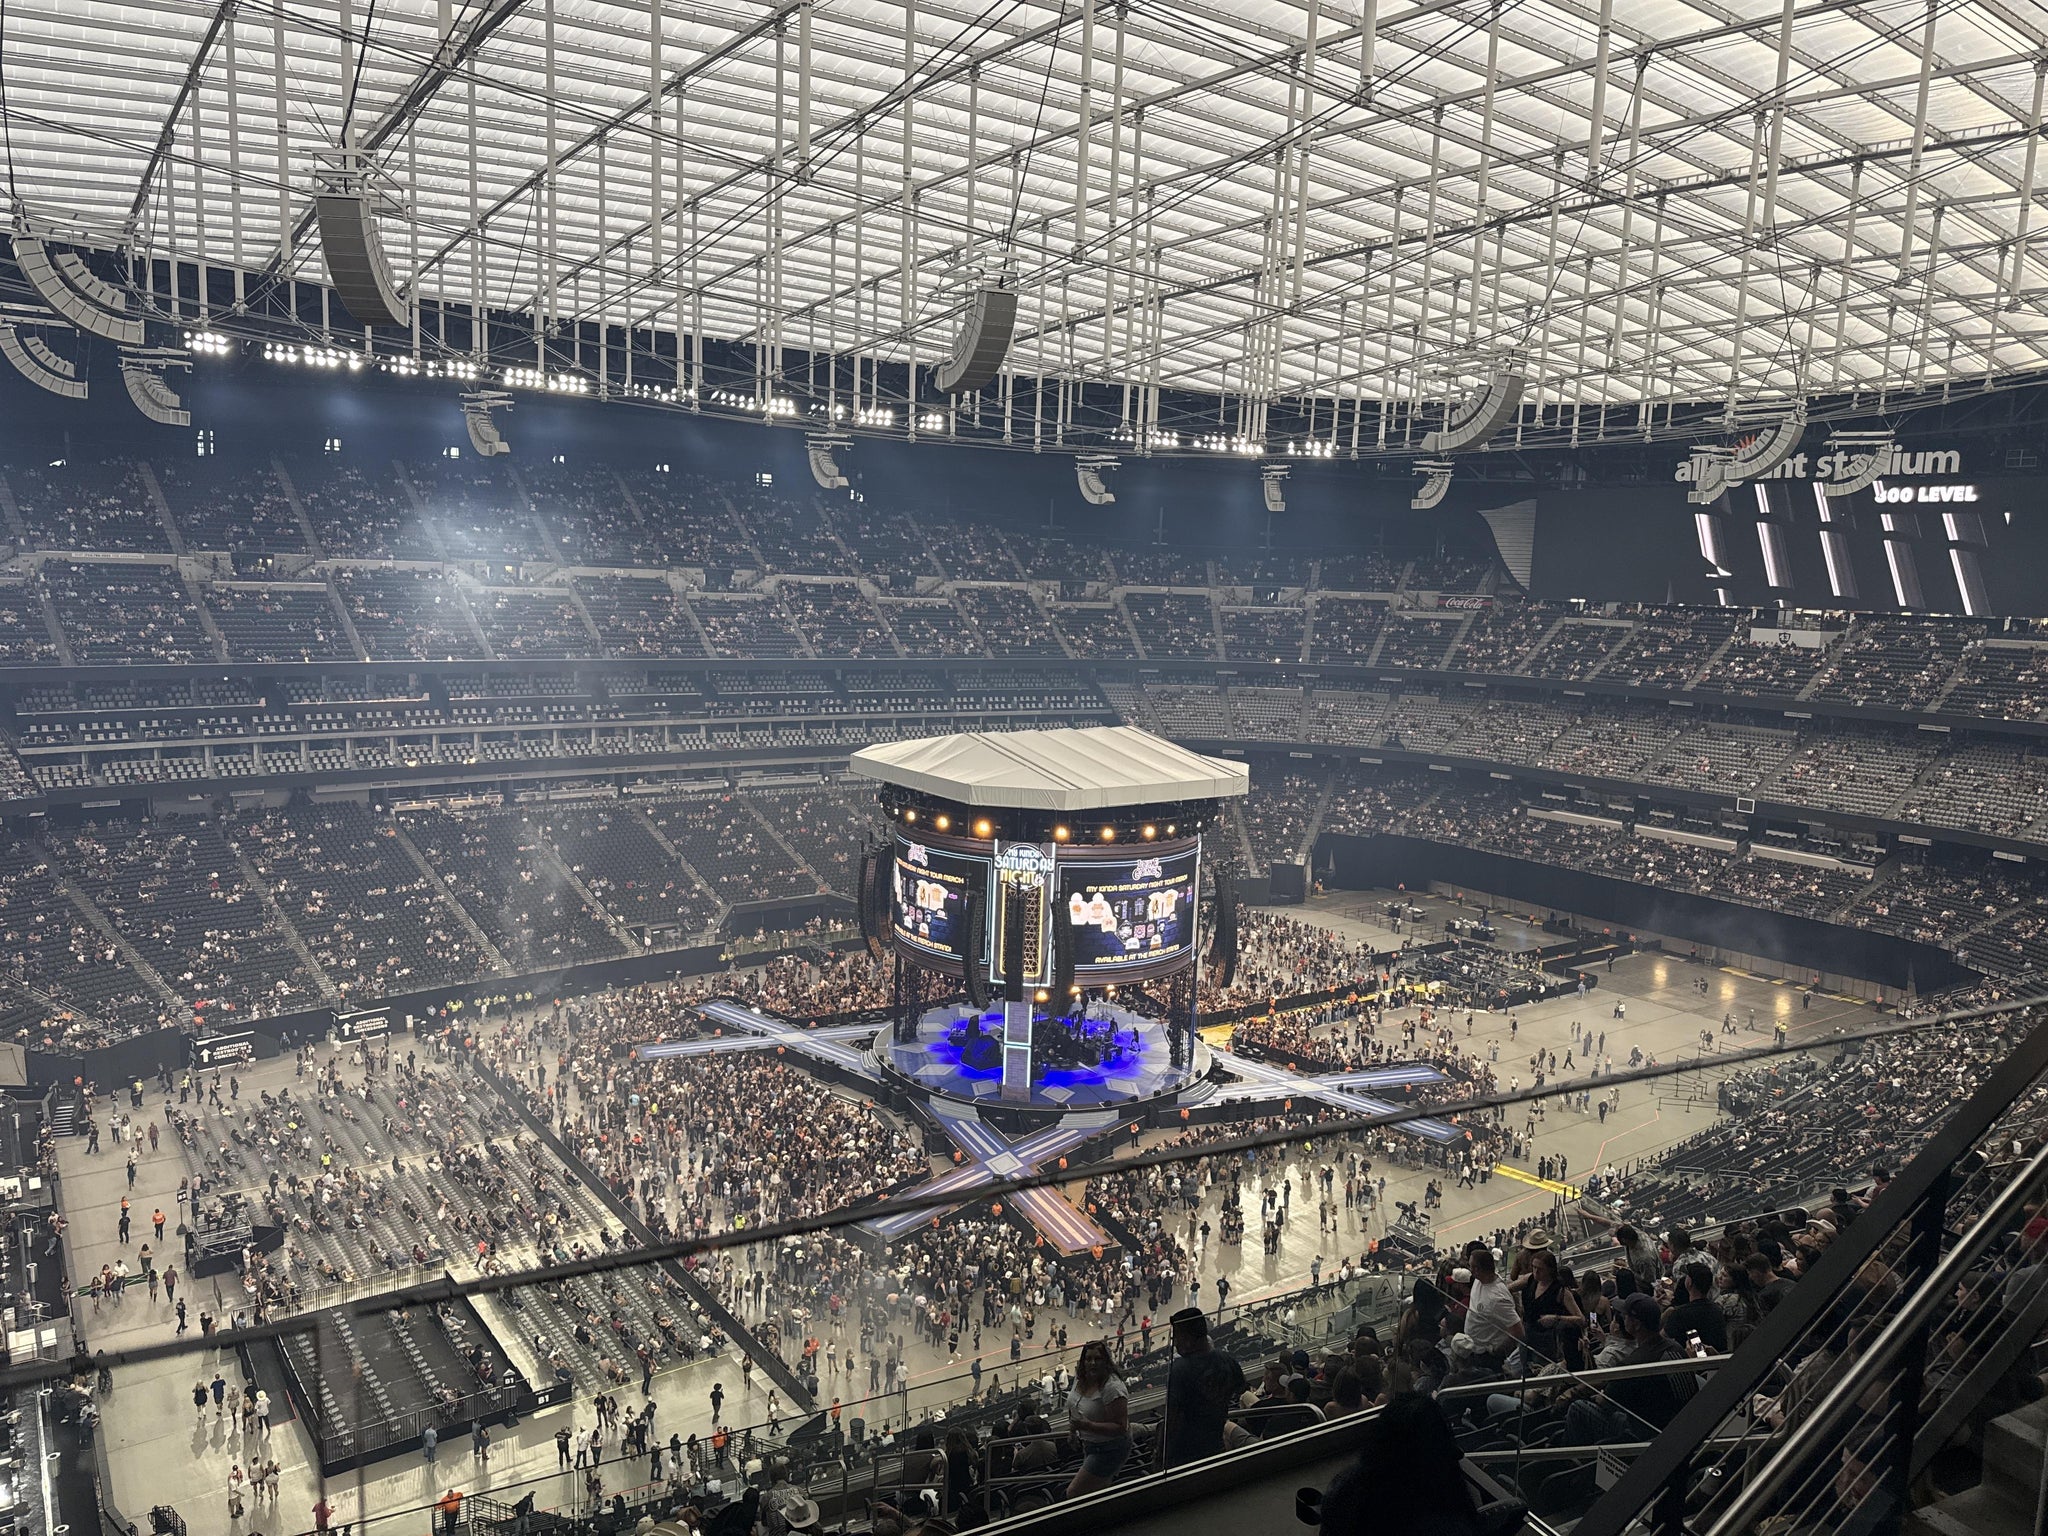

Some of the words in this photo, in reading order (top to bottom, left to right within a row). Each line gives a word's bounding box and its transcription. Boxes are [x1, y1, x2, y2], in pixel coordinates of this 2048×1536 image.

[1815, 445, 1960, 479] stium
[1917, 485, 1978, 502] LEVEL
[1446, 597, 1483, 609] Coca-Cola
[1007, 849, 1018, 858] MY
[1019, 849, 1042, 858] KINDA
[994, 856, 1055, 871] SATURDAY
[1000, 869, 1038, 885] NIGHT
[1119, 882, 1148, 892] SATURDAY
[1149, 880, 1164, 888] NIGHT
[1095, 954, 1128, 964] AVAILABLE
[1137, 951, 1148, 959] THE
[355, 1016, 386, 1026] ADDITIONAL
[215, 1041, 249, 1052] ADDITIONAL
[505, 1377, 514, 1385] B1
[538, 1394, 549, 1404] B1
